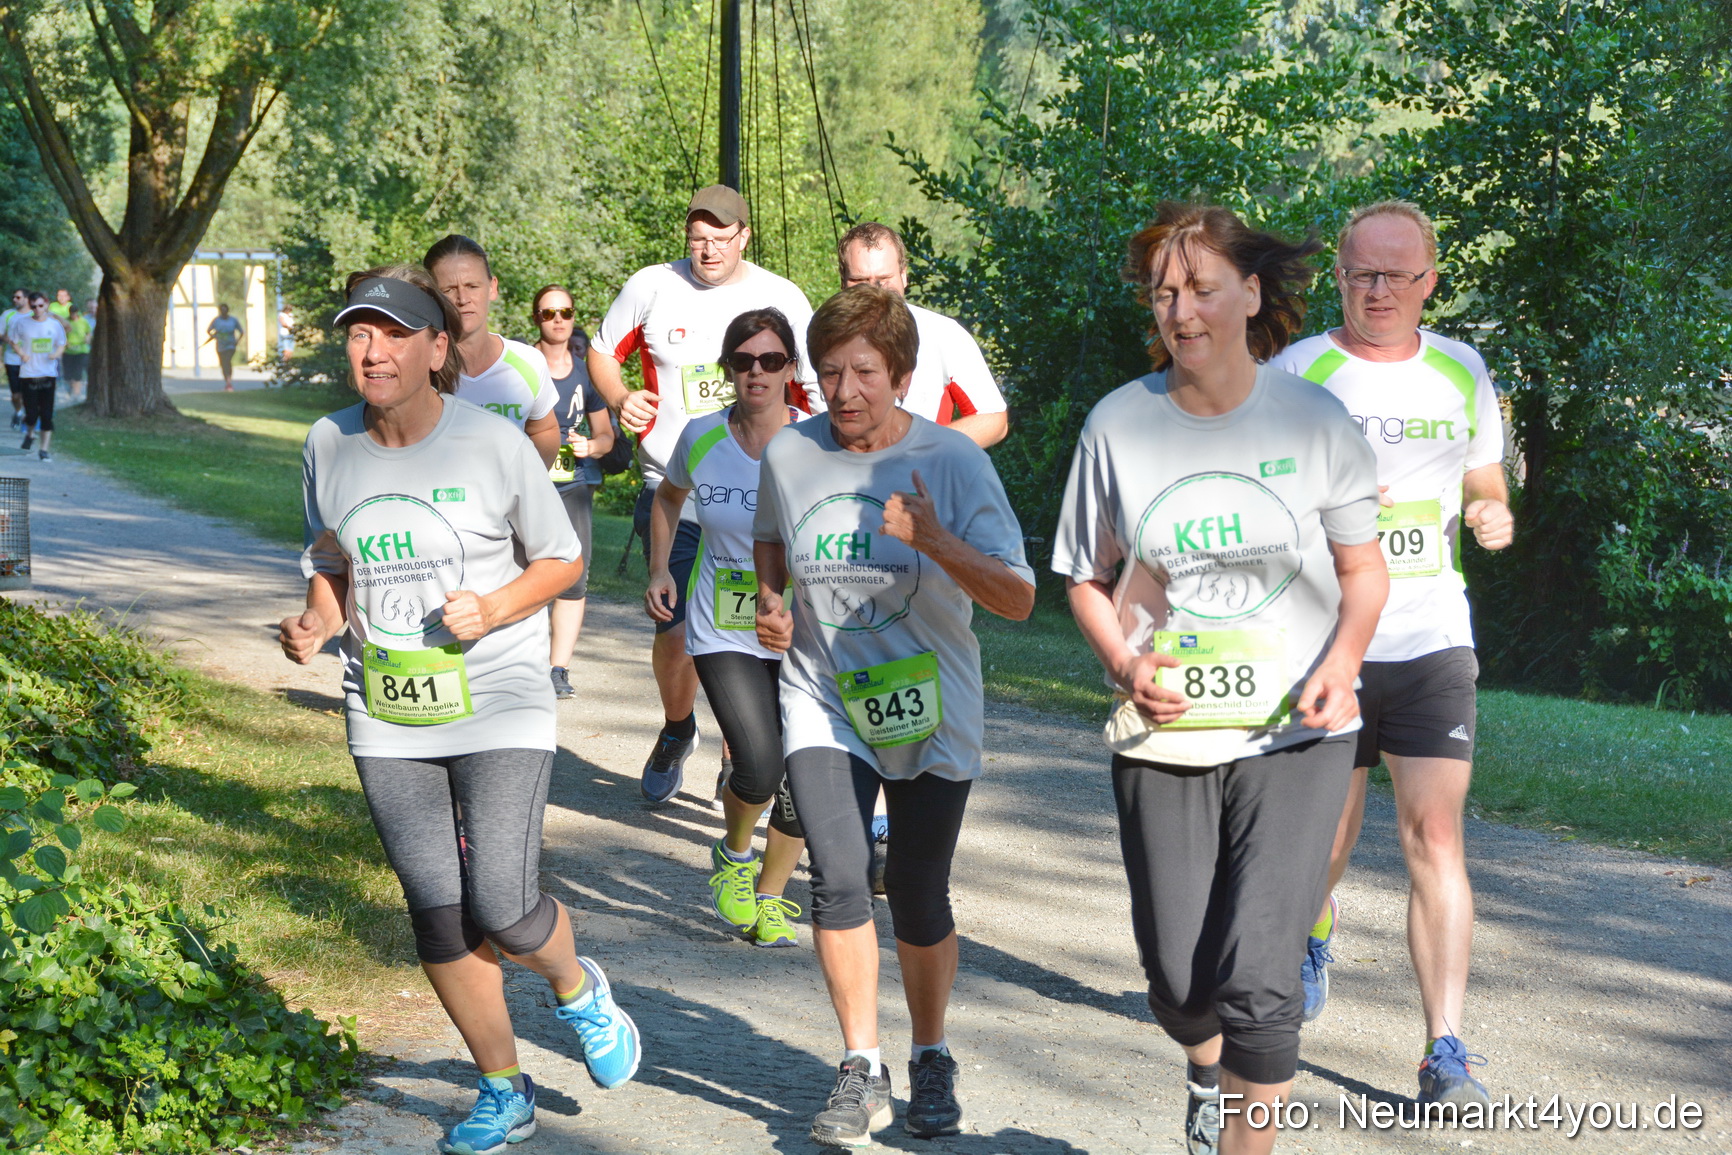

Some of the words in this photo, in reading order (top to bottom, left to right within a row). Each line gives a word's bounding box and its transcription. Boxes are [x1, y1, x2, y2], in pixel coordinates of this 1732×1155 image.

[795, 553, 810, 563] DAS
[1149, 546, 1172, 558] DAS
[1166, 557, 1189, 569] DER
[1191, 542, 1290, 562] NEPHROLOGISCHE
[356, 566, 372, 577] DER
[374, 557, 454, 575] NEPHROLOGISCHE
[804, 564, 821, 574] DER
[824, 563, 909, 574] NEPHROLOGISCHE
[382, 674, 438, 703] 841
[1184, 664, 1256, 699] 838
[374, 699, 420, 712] Weixelbaum
[421, 700, 460, 713] Angelika
[864, 687, 924, 726] 843
[869, 722, 909, 736] Bleisteiner
[911, 716, 930, 727] Maria
